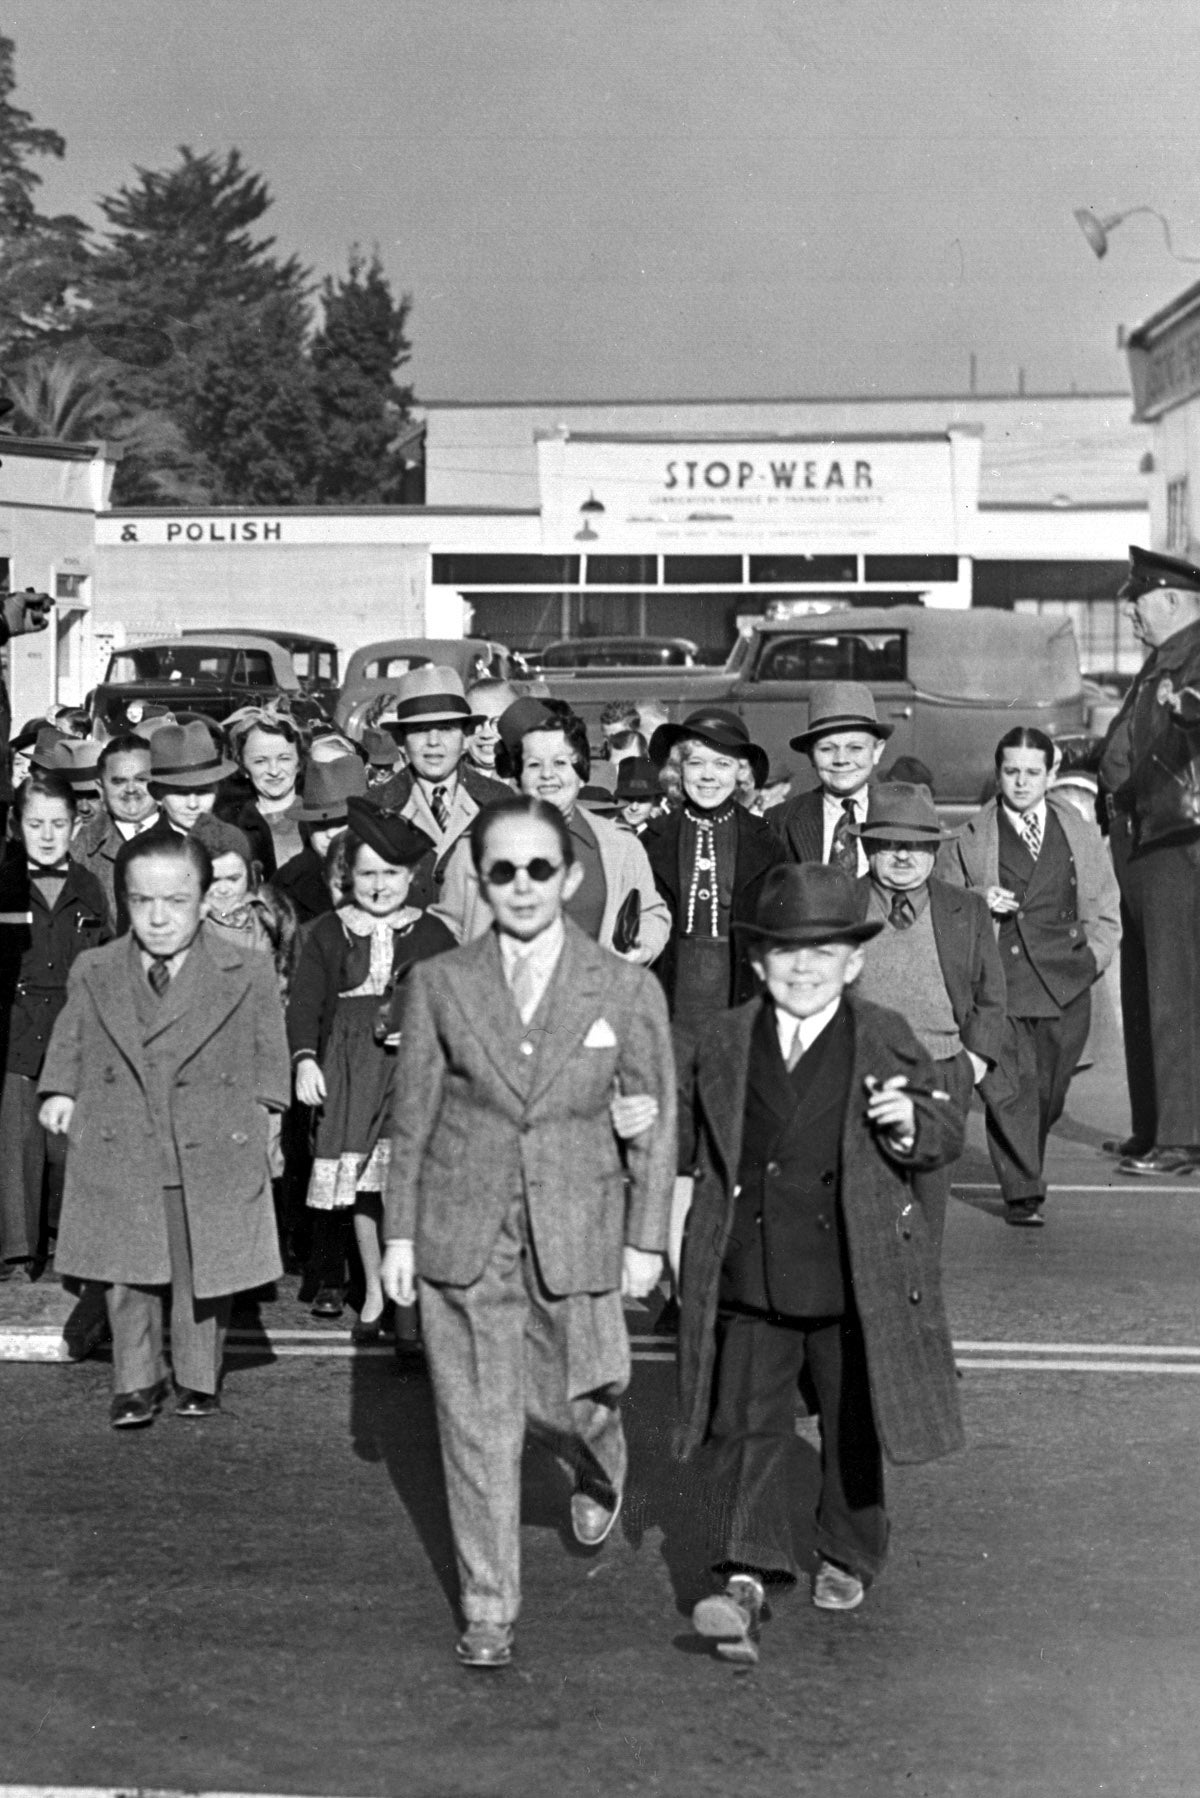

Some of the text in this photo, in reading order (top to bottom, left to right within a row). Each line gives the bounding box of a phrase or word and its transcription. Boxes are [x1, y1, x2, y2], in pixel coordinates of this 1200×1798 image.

[664, 460, 873, 490] STOP-WEAR
[120, 523, 281, 542] & POLISH
